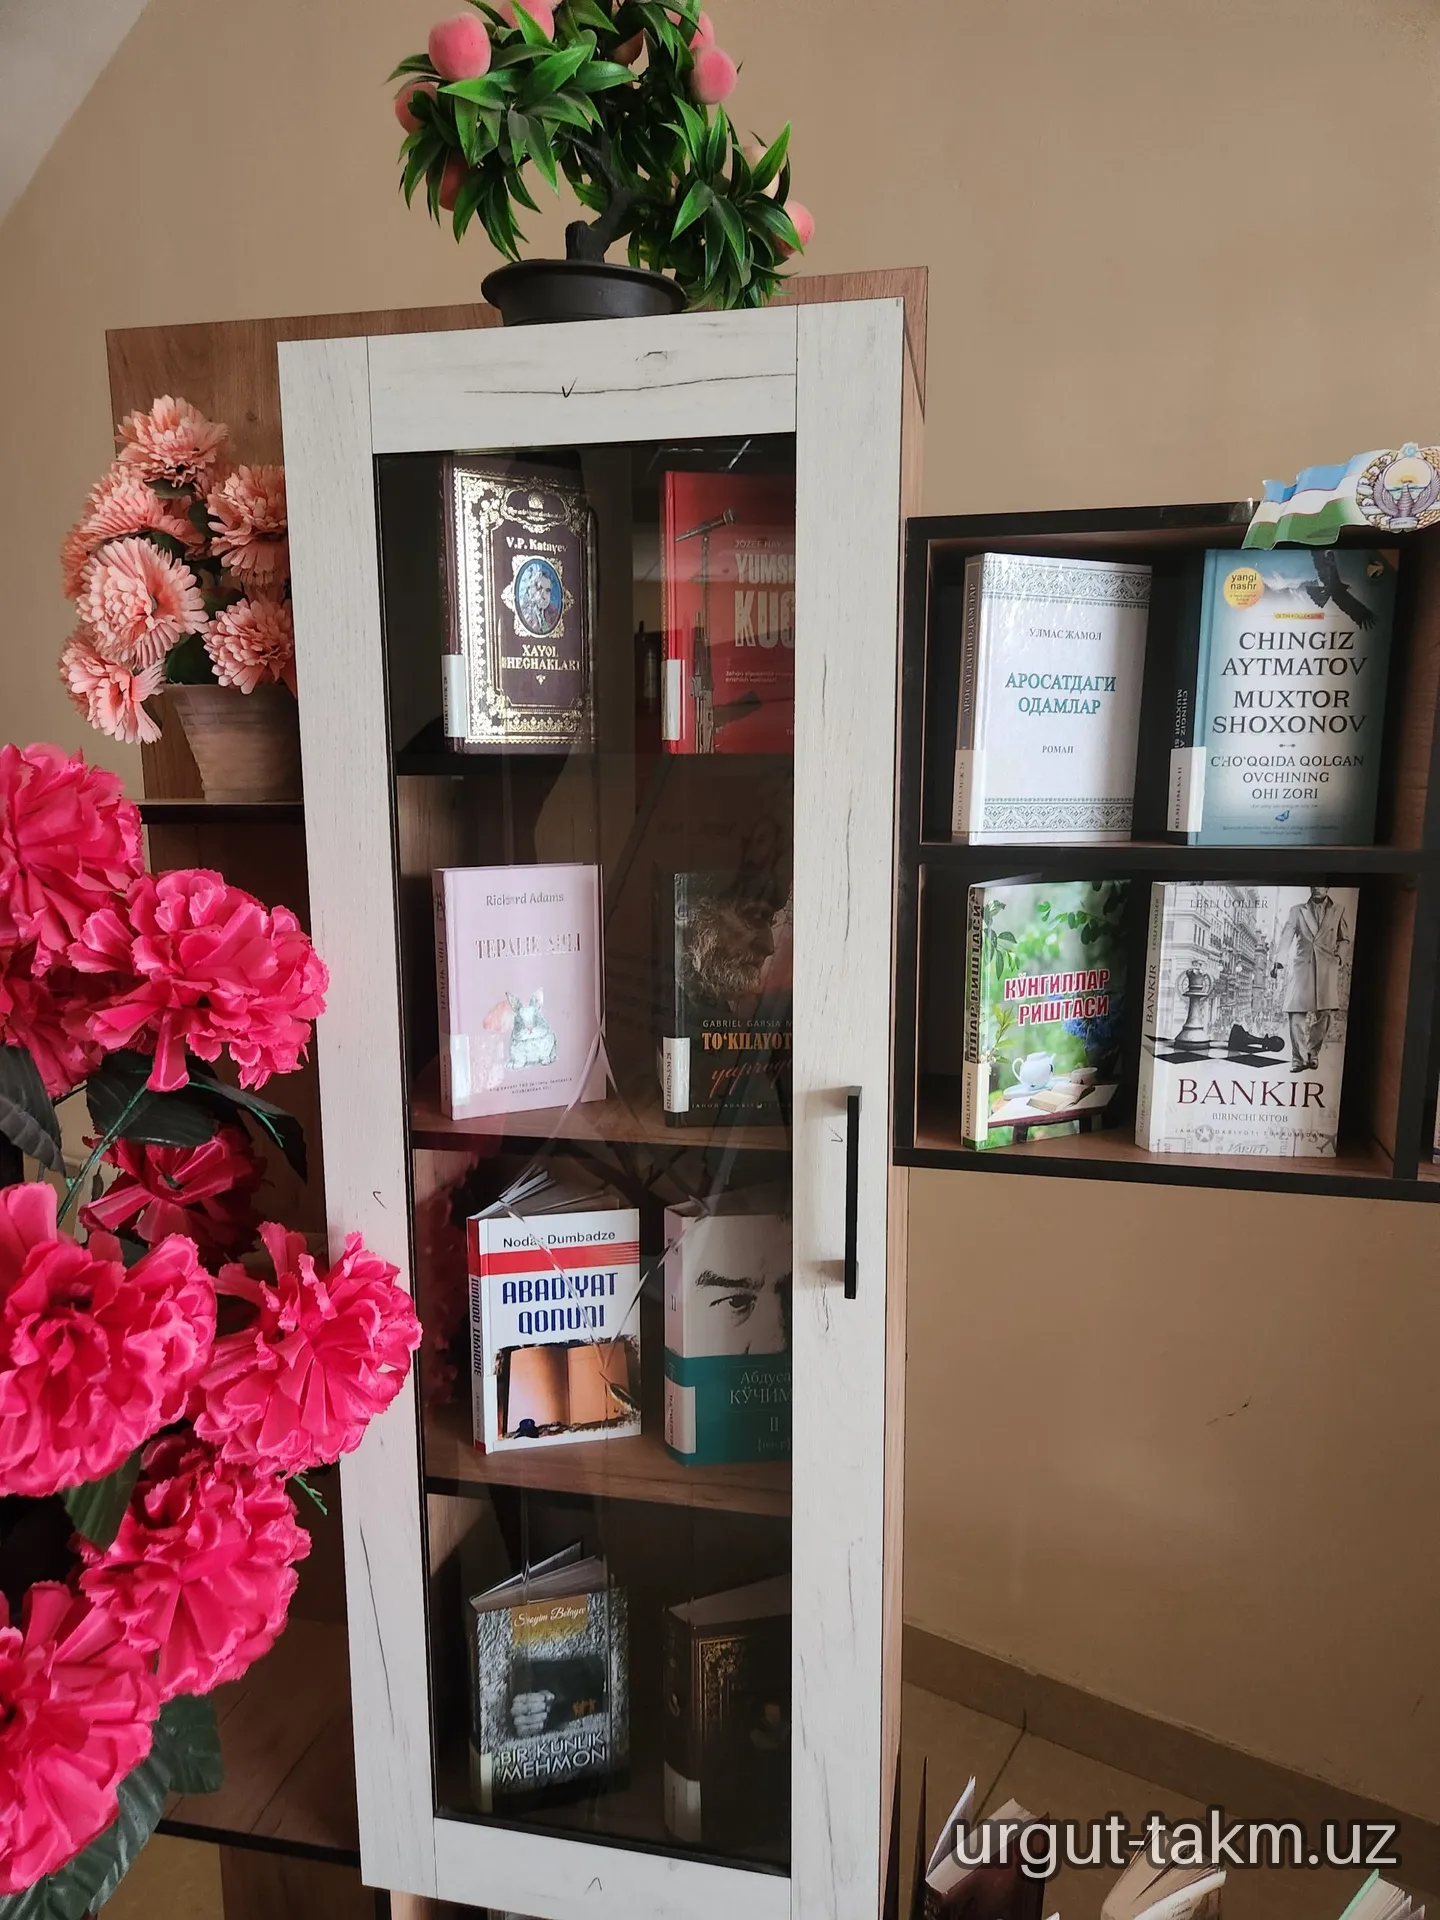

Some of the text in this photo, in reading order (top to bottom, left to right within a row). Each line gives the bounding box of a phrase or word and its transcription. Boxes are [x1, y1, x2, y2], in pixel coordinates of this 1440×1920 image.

[505, 536, 568, 555] V.P. Katayev
[1230, 582, 1257, 590] nashr
[1231, 573, 1257, 583] yangi
[1065, 631, 1102, 640] ЖАМОЛ
[1238, 631, 1356, 651] CHINGIZ
[522, 643, 559, 658] XAYOL
[1220, 656, 1368, 677] AYTMATOV
[1005, 672, 1117, 694] АРОСАТДАГИ
[1018, 697, 1101, 716] ОДАМЛАР
[1233, 690, 1351, 709] MUXTOR
[1174, 688, 1184, 735] MUXTOR
[1180, 690, 1189, 737] CHINGIZ
[1212, 715, 1368, 734] SHOXONOV
[1042, 745, 1074, 754] РОМАН
[1299, 756, 1364, 767] QOLGAN
[1243, 772, 1329, 783] OVCHINING
[1252, 788, 1318, 799] OHI ZORI
[530, 892, 564, 903] Adams
[1003, 969, 1111, 1001] КЎНГИЛЛАР
[1145, 965, 1157, 1025] BANKIR
[1018, 995, 1110, 1026] РИШТАСИ
[702, 1019, 741, 1028] GABRIEL
[1177, 1079, 1325, 1108] BANKIR
[1212, 1113, 1289, 1123] BIRINCHI KITOB
[547, 1231, 616, 1244] Dumbadze
[502, 1272, 619, 1305] ABADIYAT
[518, 1304, 605, 1335] QONUNI
[501, 1731, 605, 1766] BIR KUNLIK
[501, 1745, 606, 1784] MEHMON
